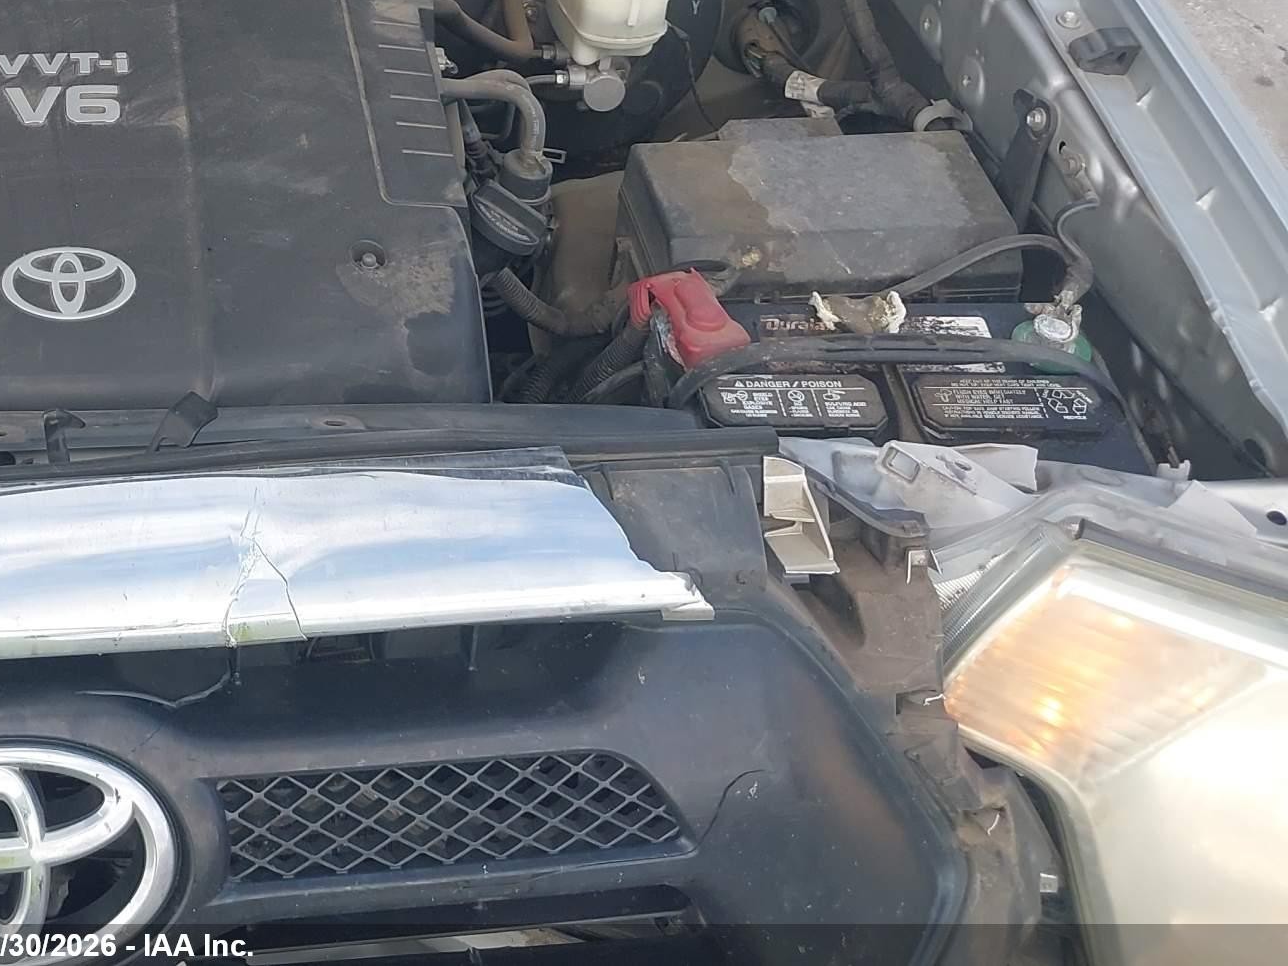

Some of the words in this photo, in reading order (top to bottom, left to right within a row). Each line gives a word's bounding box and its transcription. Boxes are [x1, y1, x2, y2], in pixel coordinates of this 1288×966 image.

[3, 84, 121, 125] V6
[745, 380, 791, 388] DANGER
[801, 380, 843, 388] POISON
